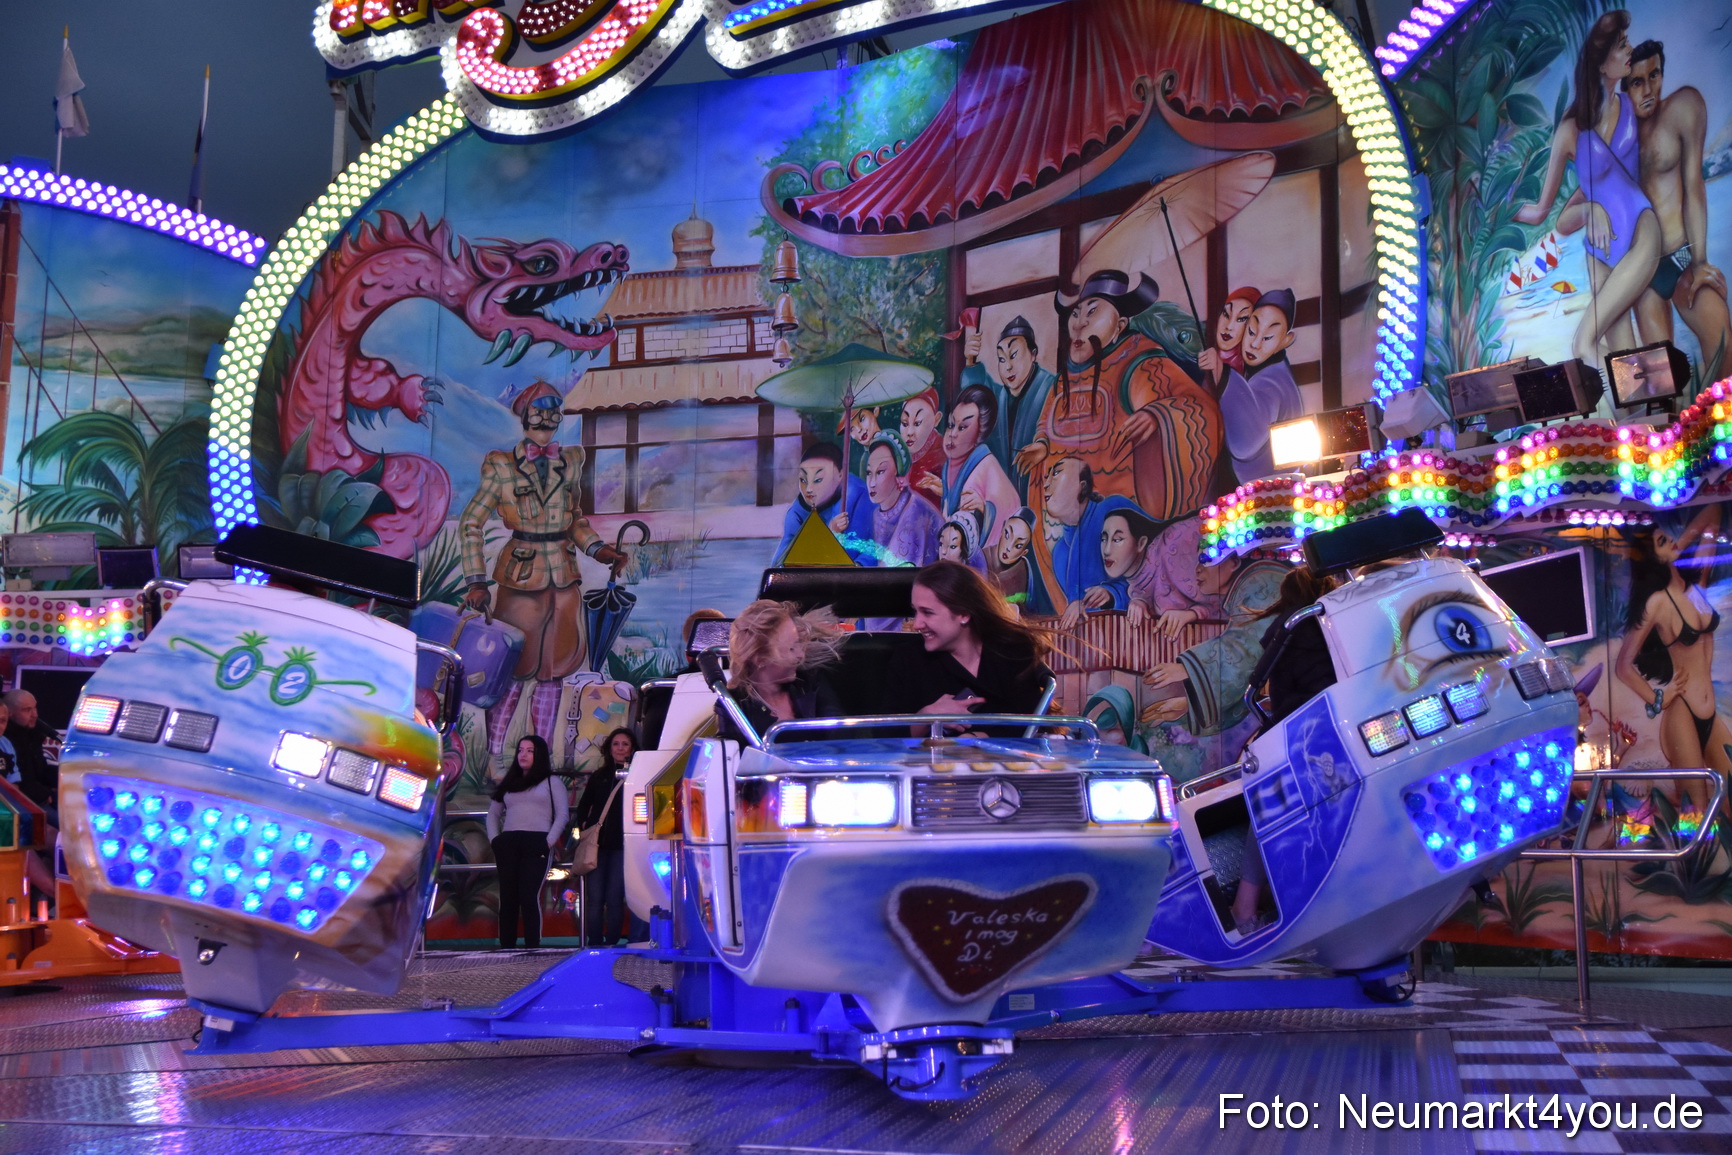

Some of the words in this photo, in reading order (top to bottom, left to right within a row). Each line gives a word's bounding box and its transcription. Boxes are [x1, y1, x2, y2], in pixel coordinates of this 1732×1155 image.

[1455, 622, 1471, 645] 4
[948, 907, 1049, 926] Valeska
[977, 929, 1019, 946] mog
[956, 941, 996, 962] Di
